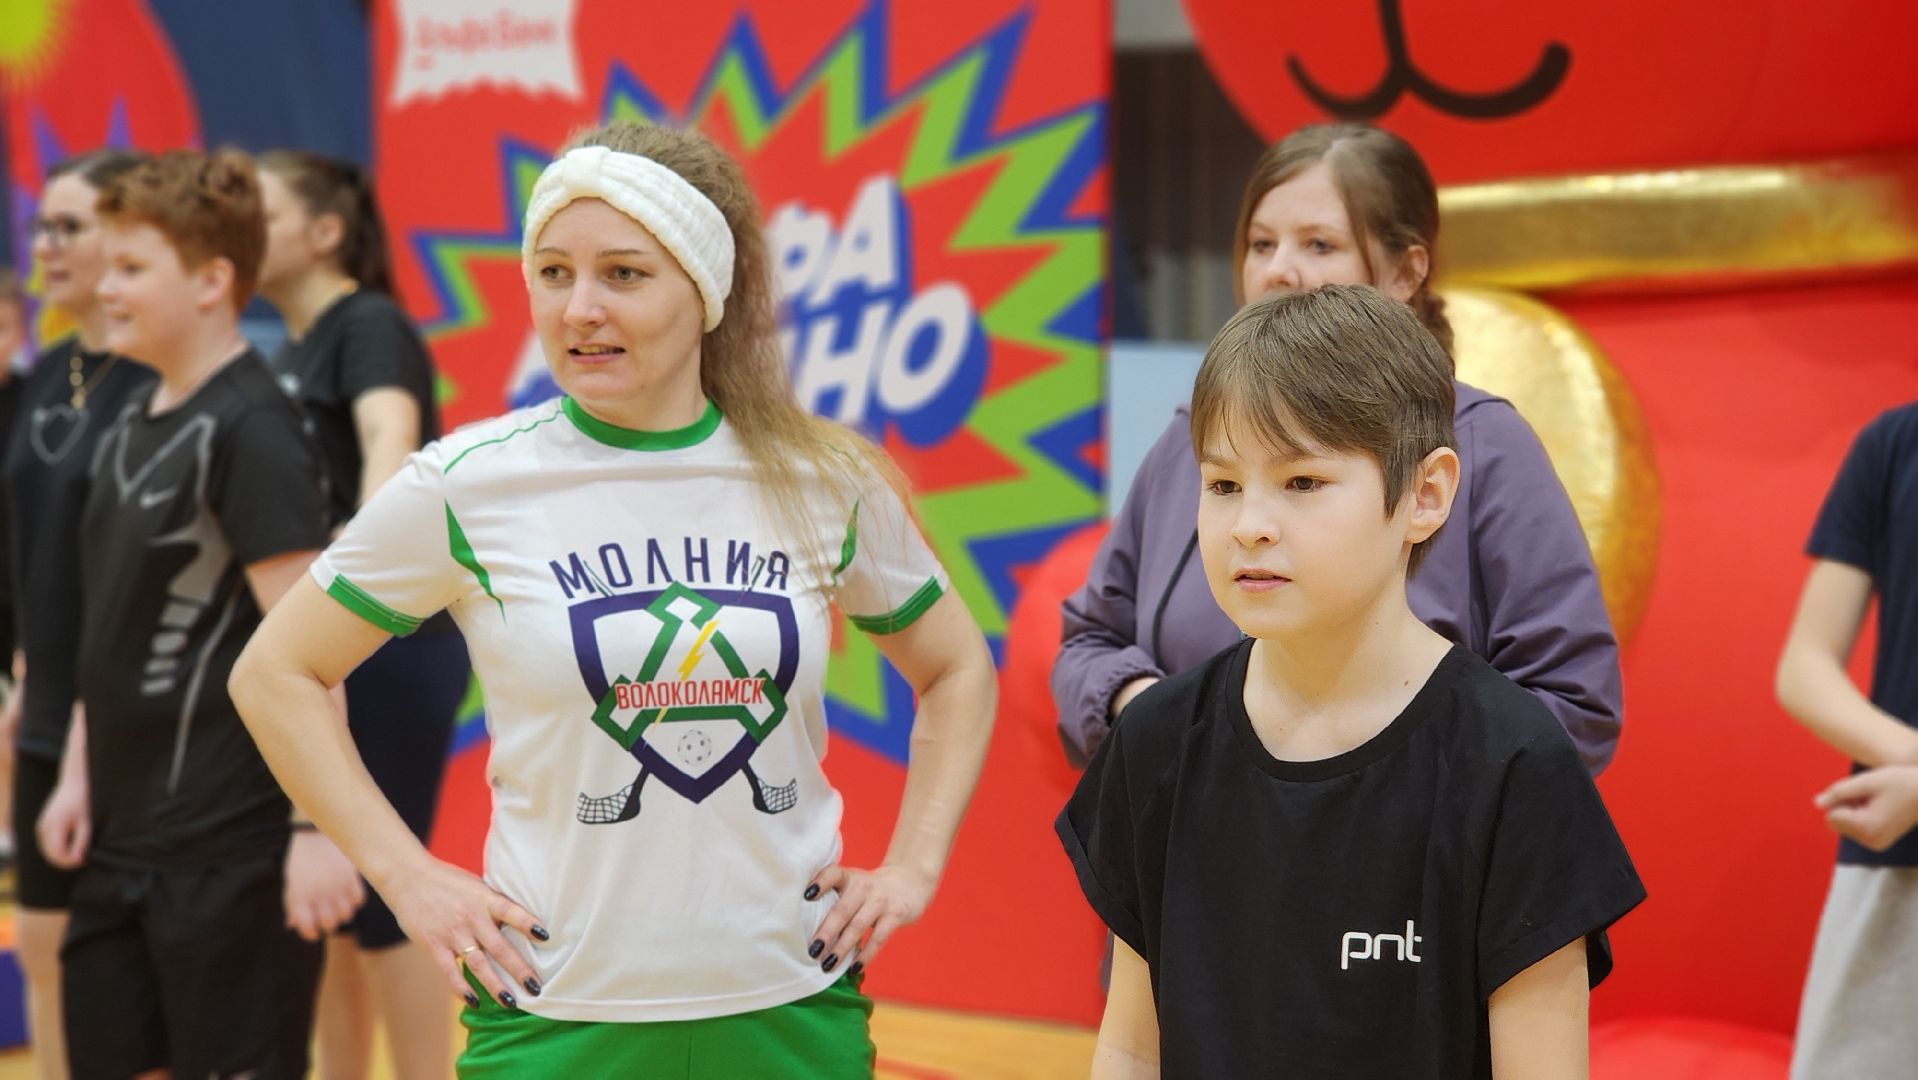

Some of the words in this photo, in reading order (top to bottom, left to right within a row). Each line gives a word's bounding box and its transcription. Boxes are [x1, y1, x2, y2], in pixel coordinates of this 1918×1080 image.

[549, 537, 790, 598] МОЛНИЯ
[615, 677, 767, 710] ВОЛОКОЛАМСК
[1341, 919, 1423, 970] pnt
